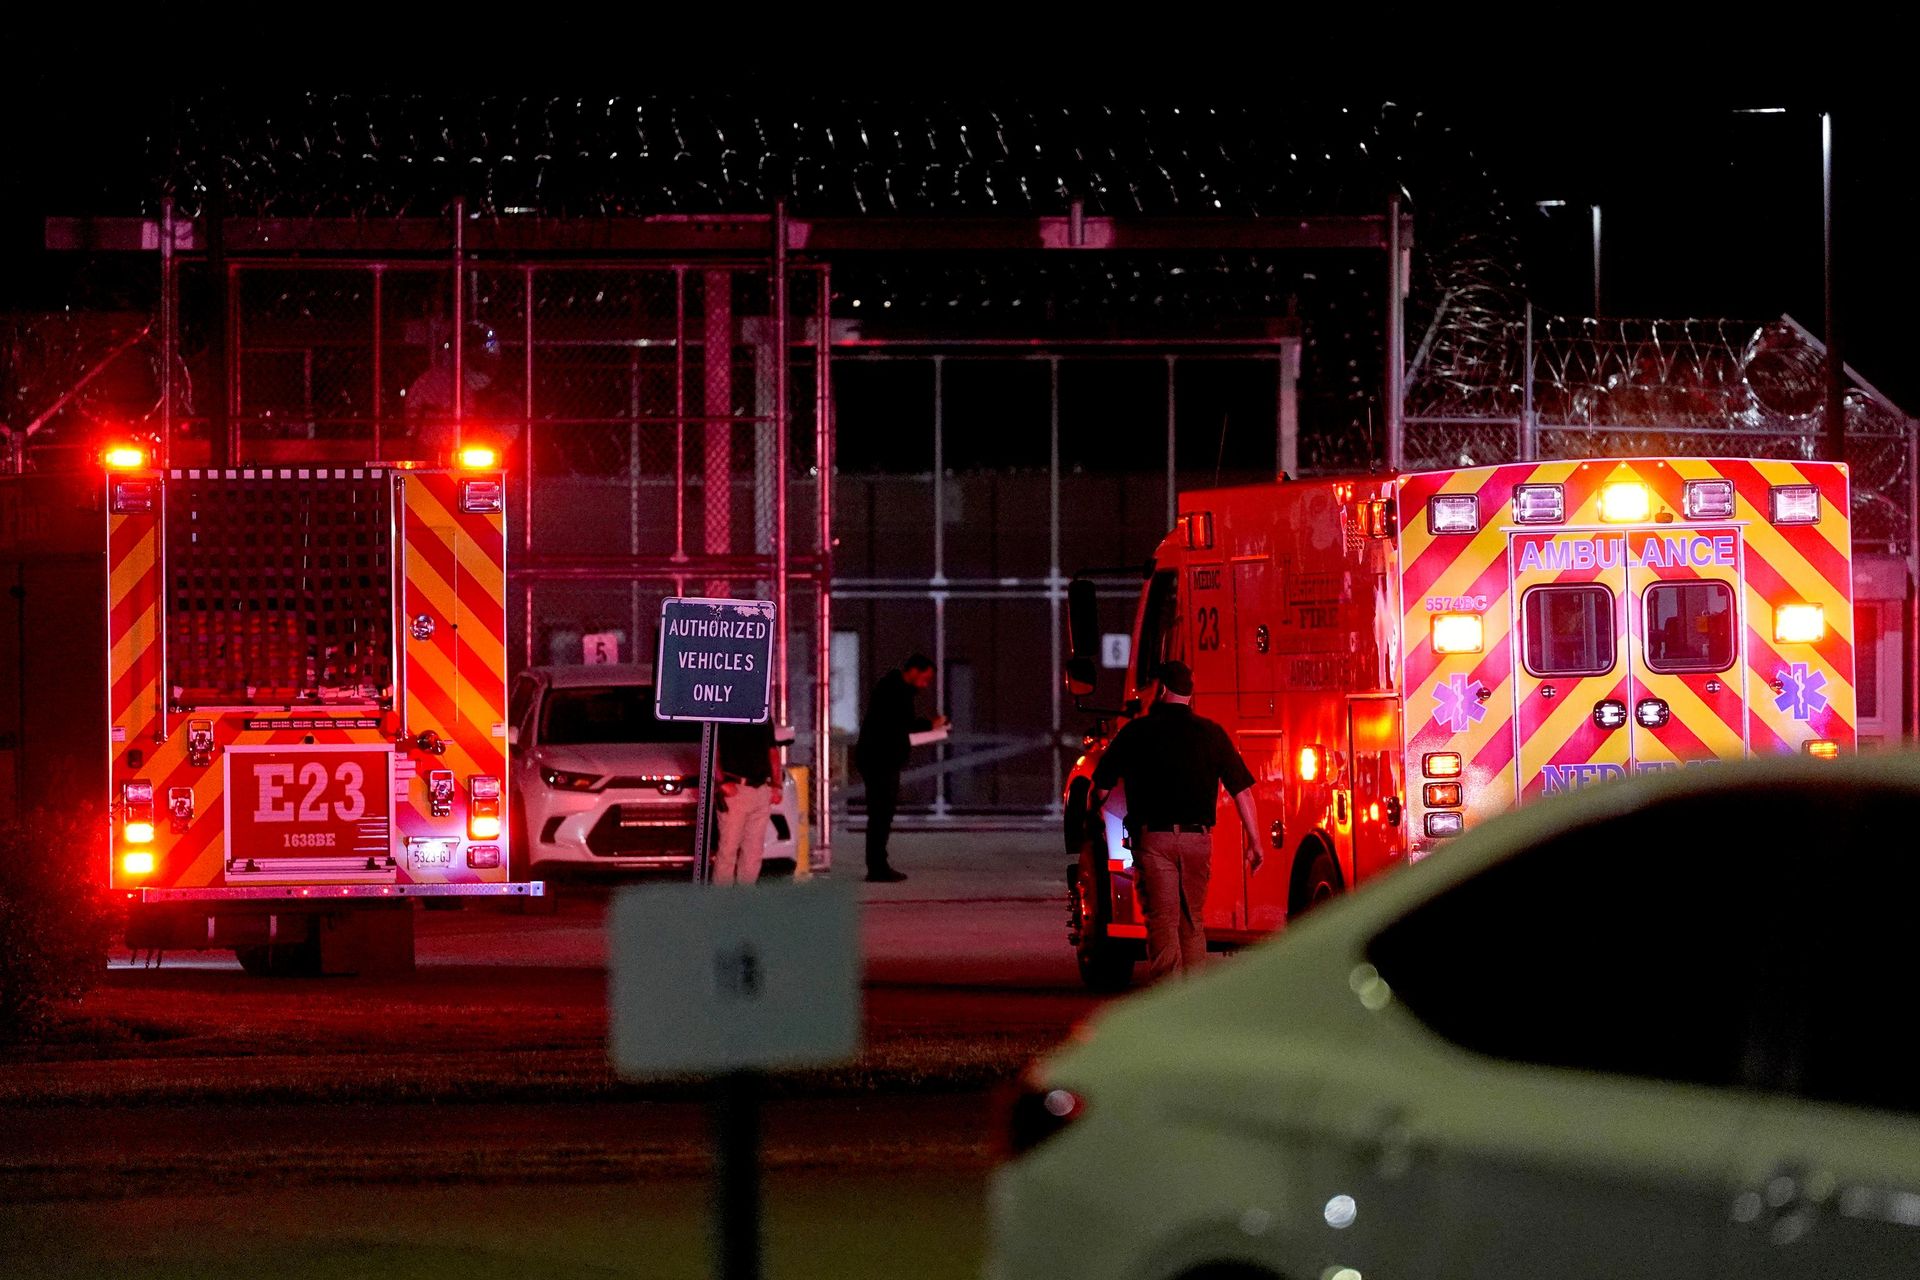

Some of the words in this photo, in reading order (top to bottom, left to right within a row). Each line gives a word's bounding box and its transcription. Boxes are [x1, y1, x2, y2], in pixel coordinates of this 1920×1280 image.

[1518, 537, 1736, 571] AMBULANCE
[1193, 570, 1222, 590] MEDIC
[1425, 595, 1488, 612] 5574BC
[668, 618, 767, 640] AUTHORIZED
[1198, 607, 1220, 651] 23
[1298, 608, 1340, 629] FIRE
[595, 641, 608, 665] 5
[678, 651, 755, 673] VEHICLES
[693, 683, 734, 703] ONLY
[253, 761, 366, 822] E23
[283, 833, 336, 848] 1638BE
